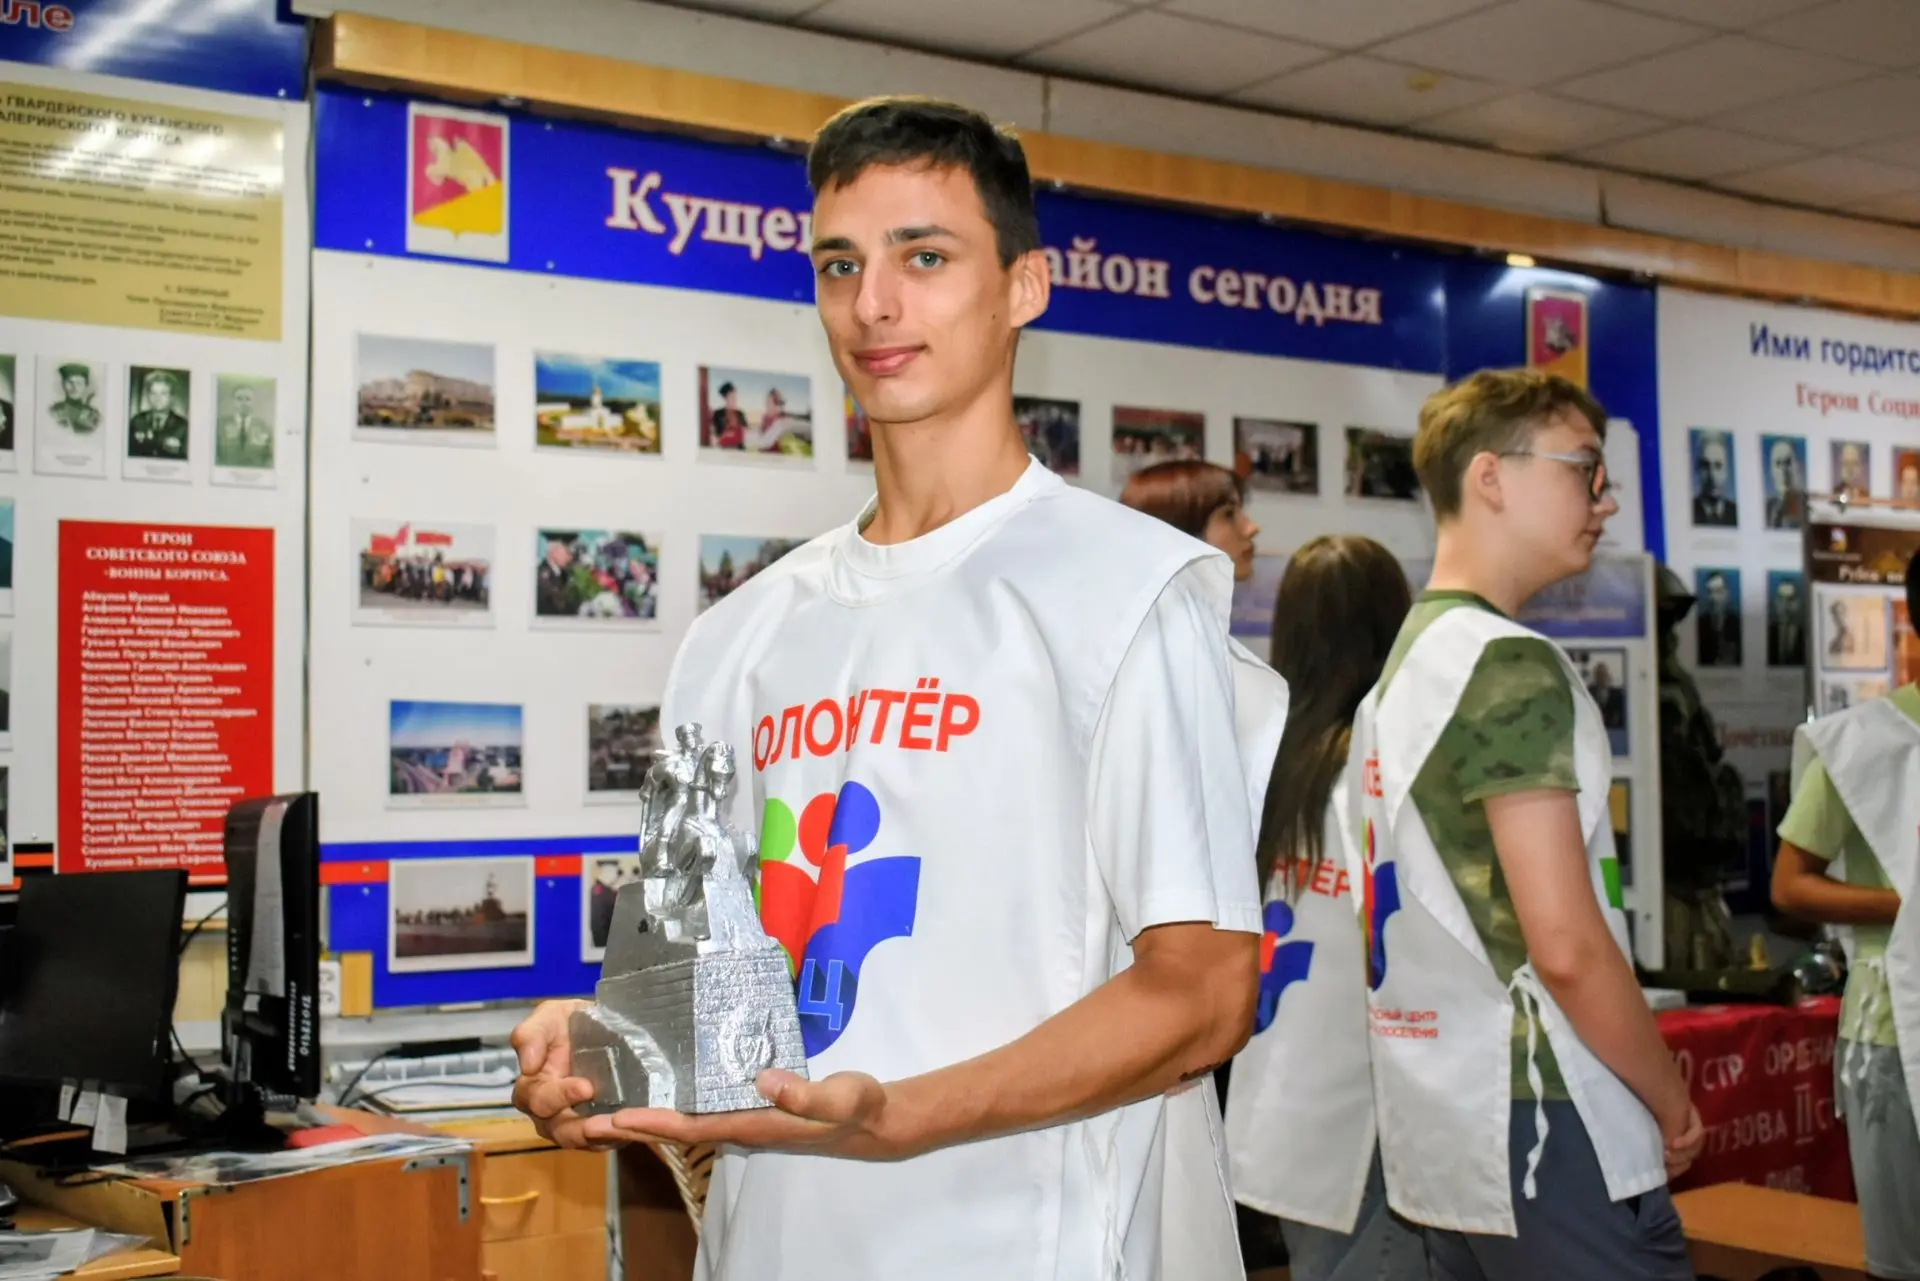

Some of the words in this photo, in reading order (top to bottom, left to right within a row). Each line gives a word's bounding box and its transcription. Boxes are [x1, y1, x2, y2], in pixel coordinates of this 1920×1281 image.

[1044, 236, 1170, 298] айон
[1188, 265, 1383, 327] сегодня
[1749, 321, 1811, 361] Ими
[86, 547, 189, 563] СОВЕТСКОГО
[191, 549, 247, 565] СОЮЗА
[752, 677, 980, 773] ОЛОНТЁР
[799, 958, 845, 1032] Ц
[1704, 1110, 1787, 1154] ТУЗОВА
